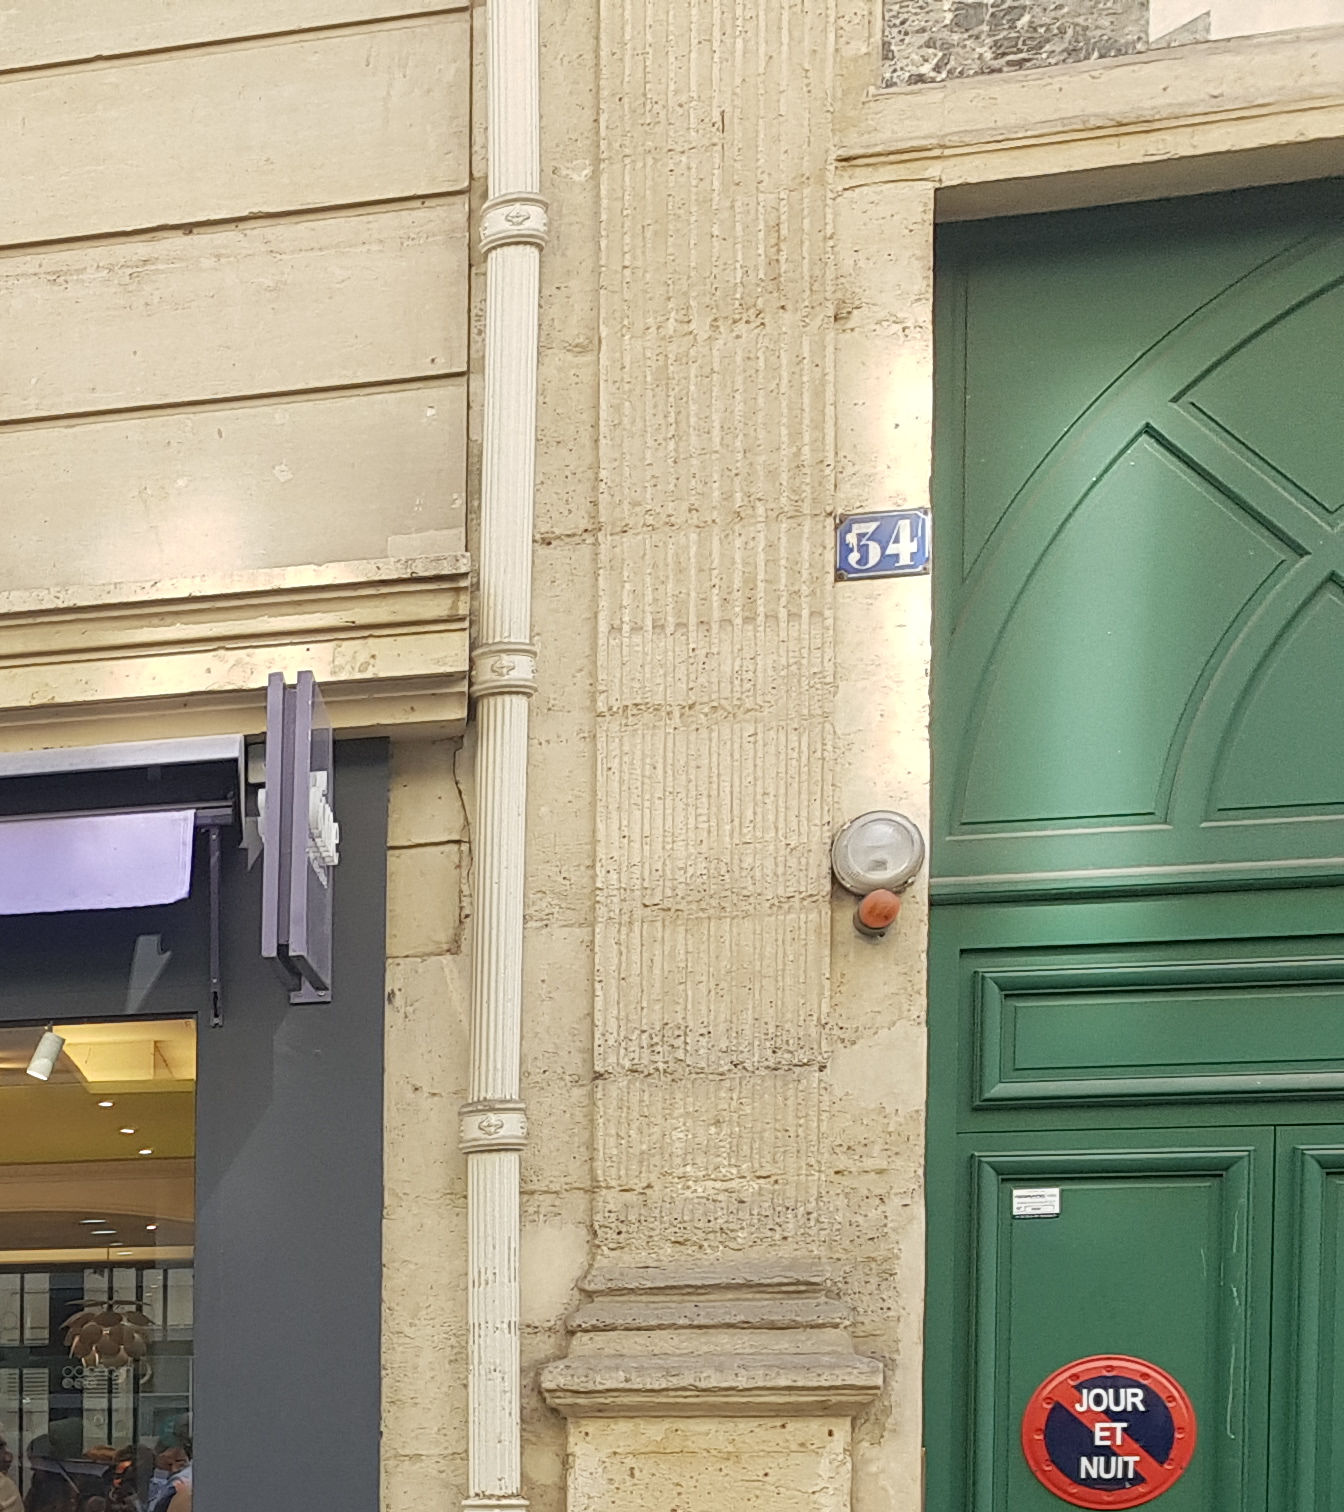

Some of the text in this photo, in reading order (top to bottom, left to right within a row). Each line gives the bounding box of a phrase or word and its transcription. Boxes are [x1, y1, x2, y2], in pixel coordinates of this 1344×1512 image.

[1074, 1387, 1146, 1413] JOUR
[1093, 1422, 1128, 1446] ET
[1079, 1456, 1140, 1479] NUIT
